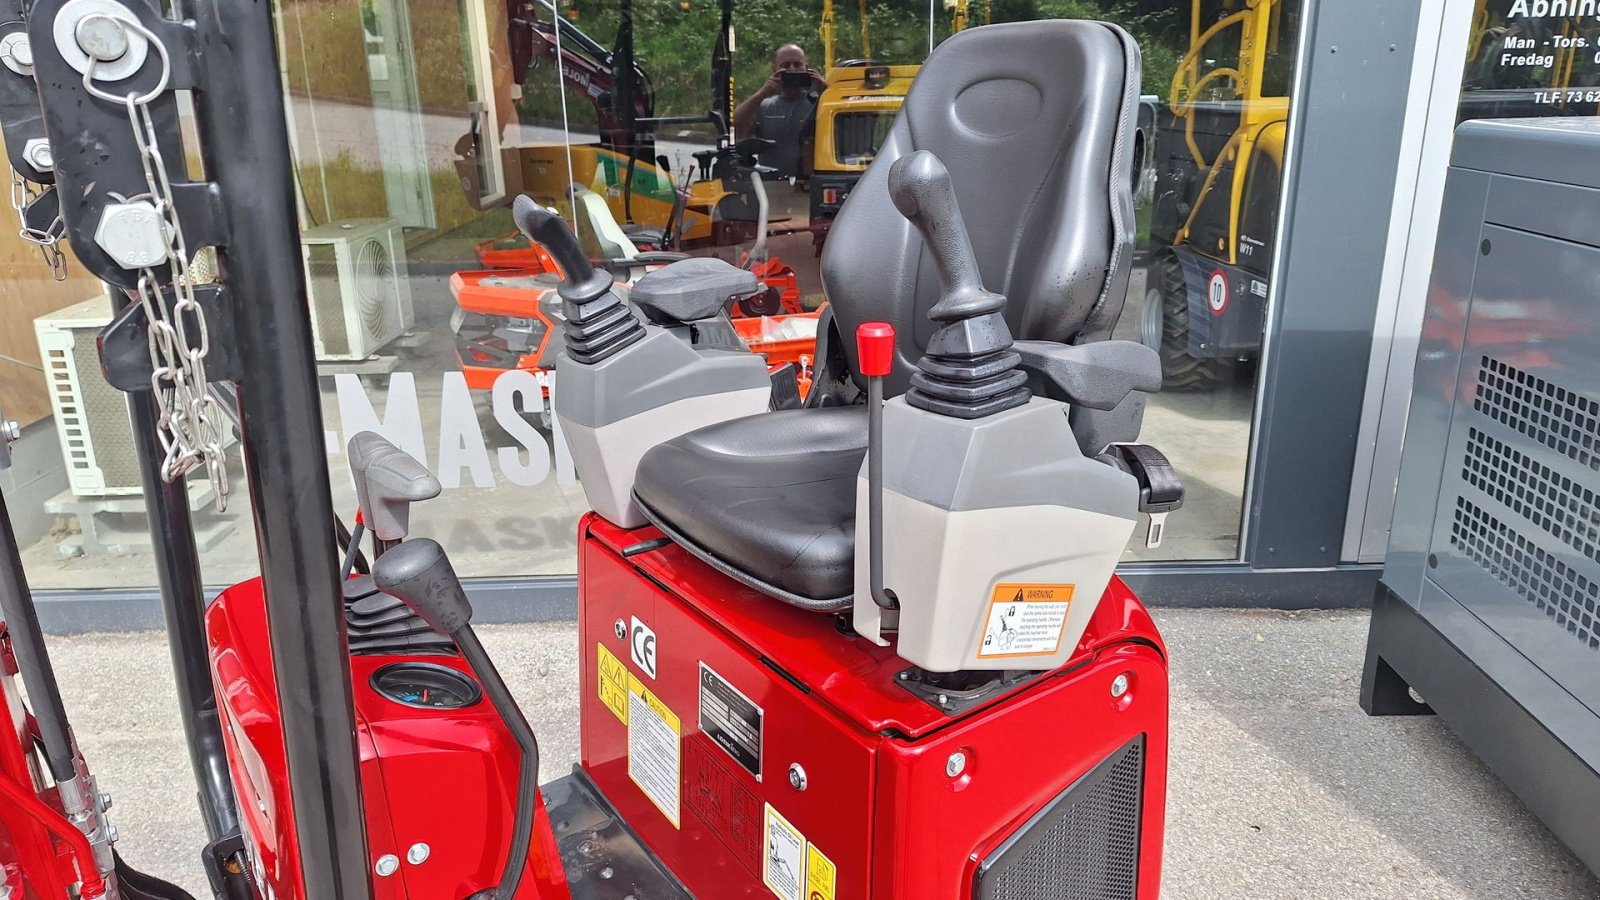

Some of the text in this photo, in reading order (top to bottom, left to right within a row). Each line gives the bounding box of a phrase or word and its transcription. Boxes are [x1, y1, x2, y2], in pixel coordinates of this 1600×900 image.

[1504, 36, 1536, 49] Man
[1552, 35, 1590, 48] Tors.
[1500, 53, 1554, 68] Fredag
[1534, 92, 1562, 104] TLF.
[1567, 91, 1583, 103] 73
[1240, 243, 1254, 256] W11
[1213, 282, 1222, 303] 10
[1027, 590, 1054, 599] WARNING
[632, 622, 656, 674] CE
